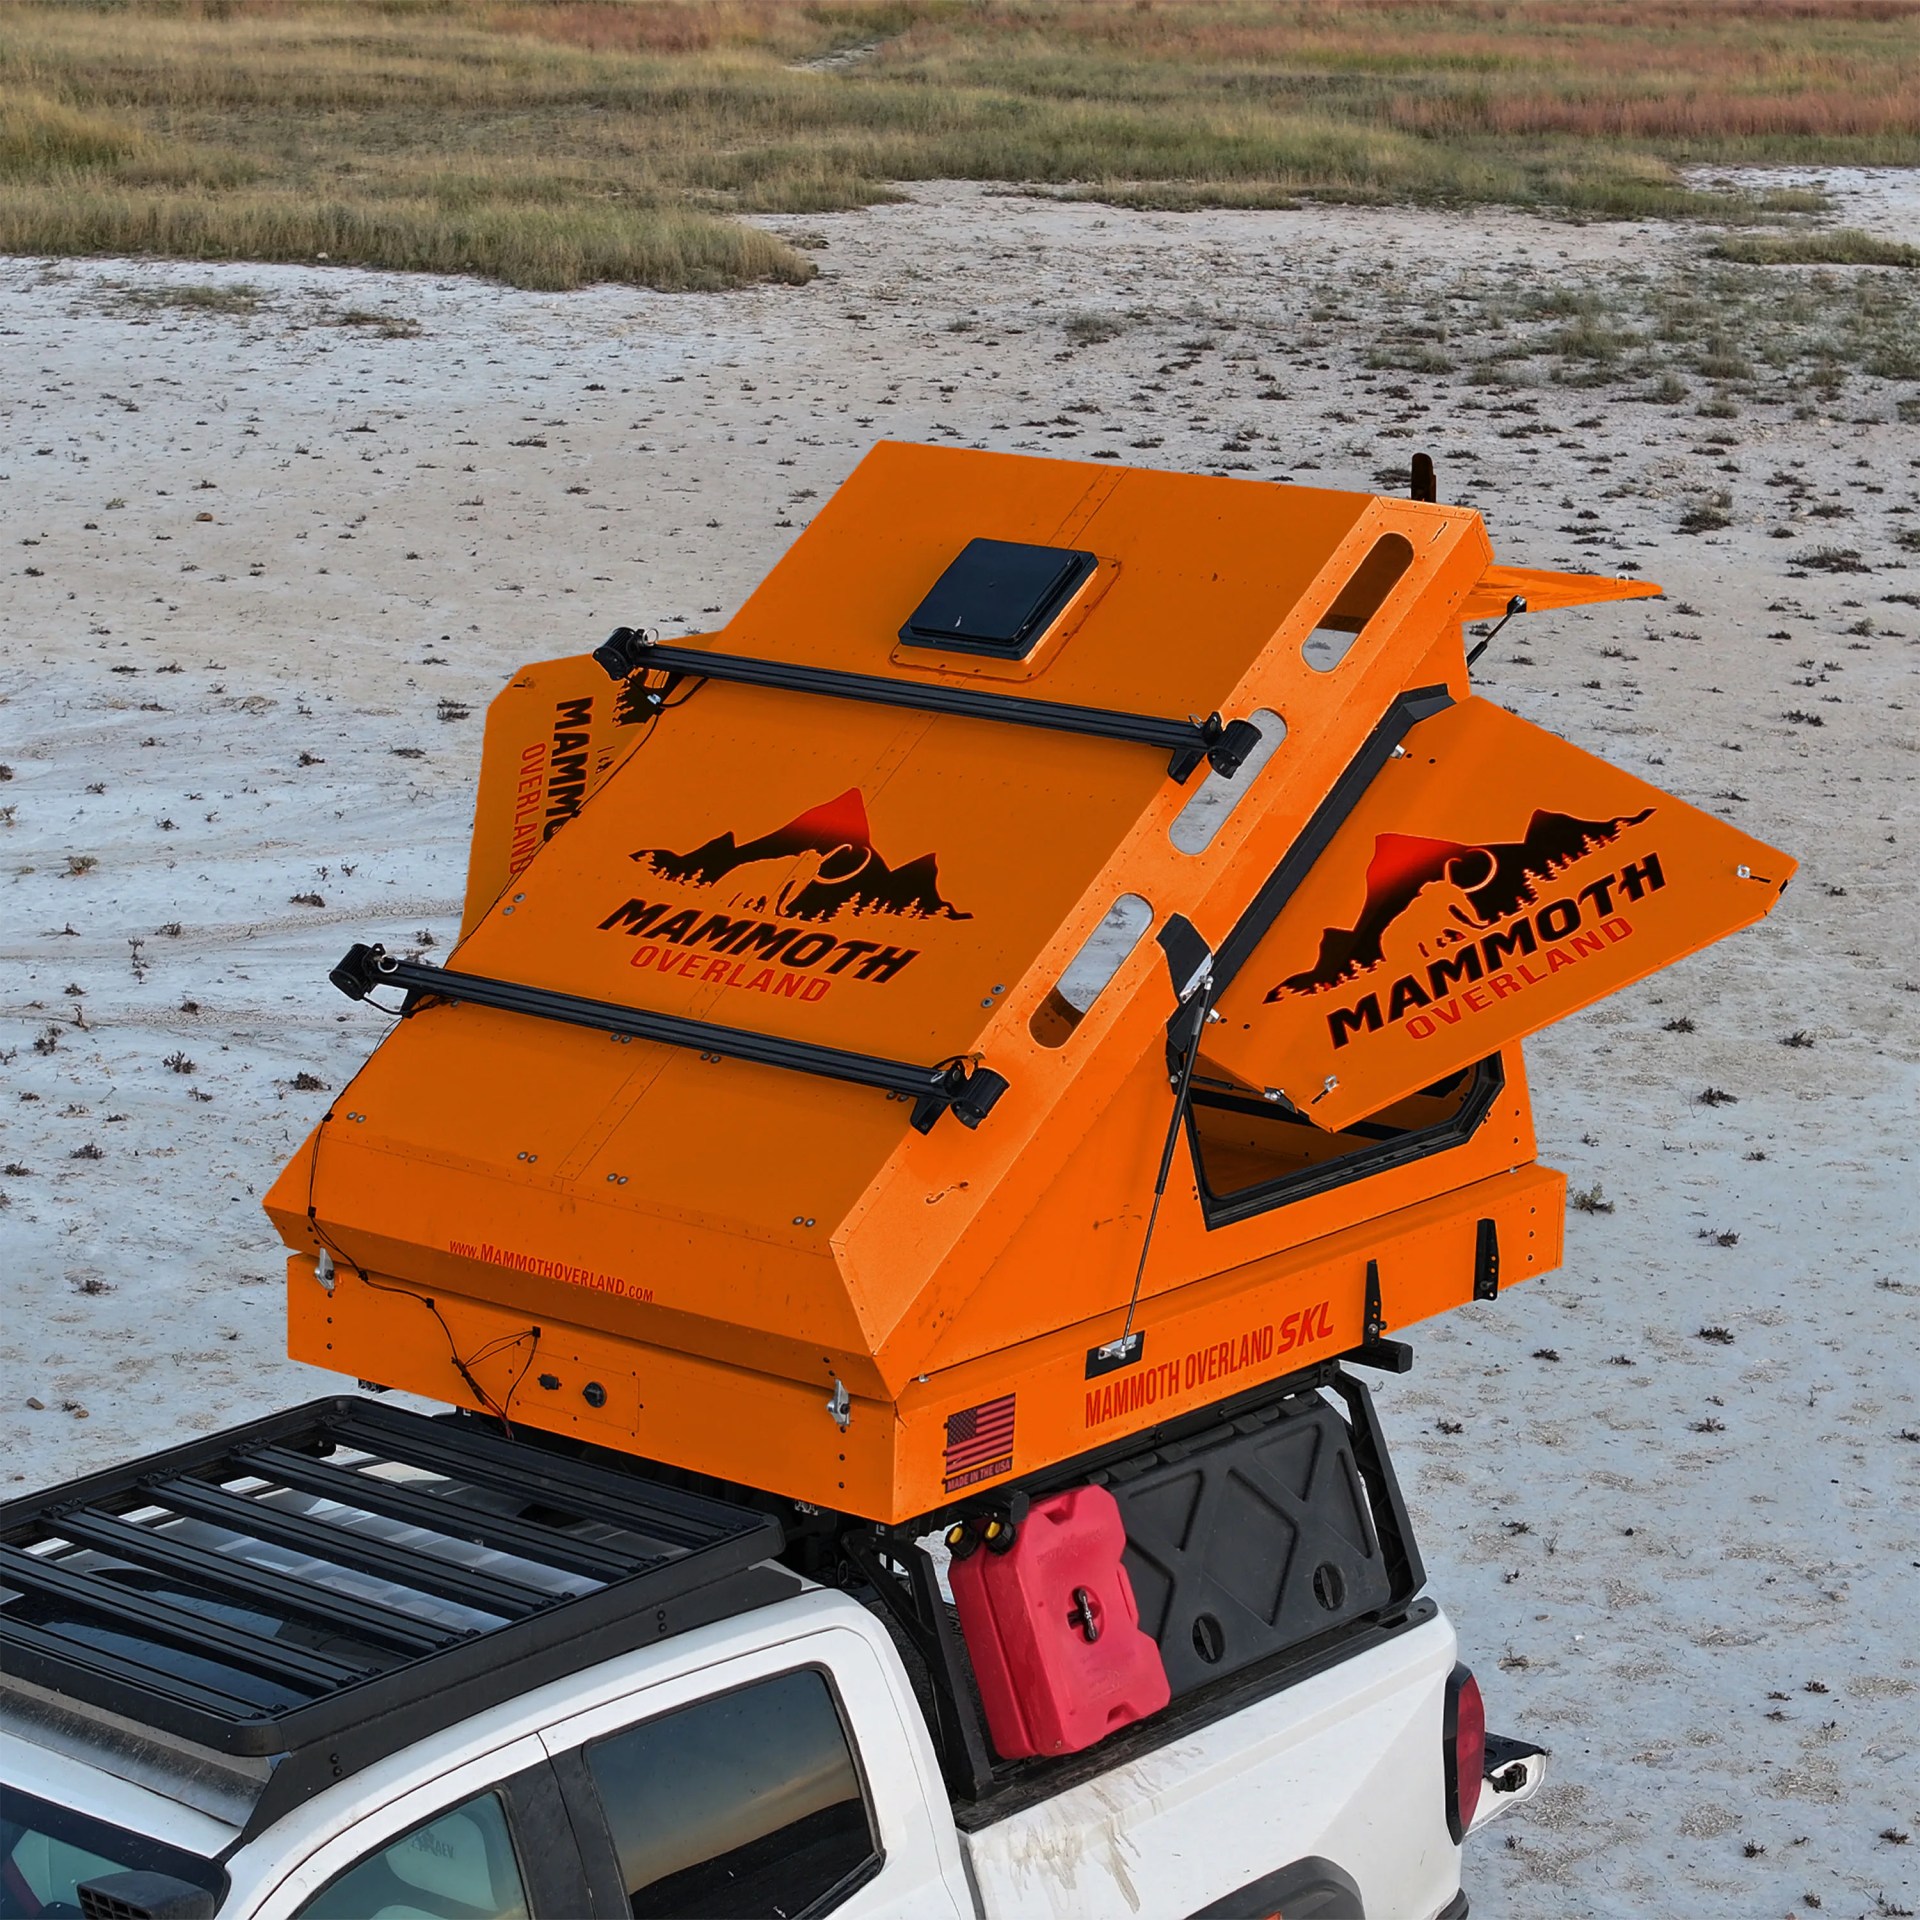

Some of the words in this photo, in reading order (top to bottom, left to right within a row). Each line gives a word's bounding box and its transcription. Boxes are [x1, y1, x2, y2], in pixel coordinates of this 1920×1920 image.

[509, 743, 546, 875] OVERLAND
[597, 898, 921, 984] MAMMOTH
[630, 945, 832, 1002] OVERLAND
[1326, 852, 1666, 1050] MAMMOTH
[1405, 916, 1633, 1040] OVERLAND
[1085, 1359, 1180, 1429] MAMMOTH
[1185, 1325, 1273, 1390] OVERLAND
[1277, 1301, 1334, 1355] SKL
[947, 1474, 969, 1491] MADE
[970, 1470, 979, 1482] IN
[980, 1464, 994, 1478] THE
[995, 1458, 1011, 1474] USA
